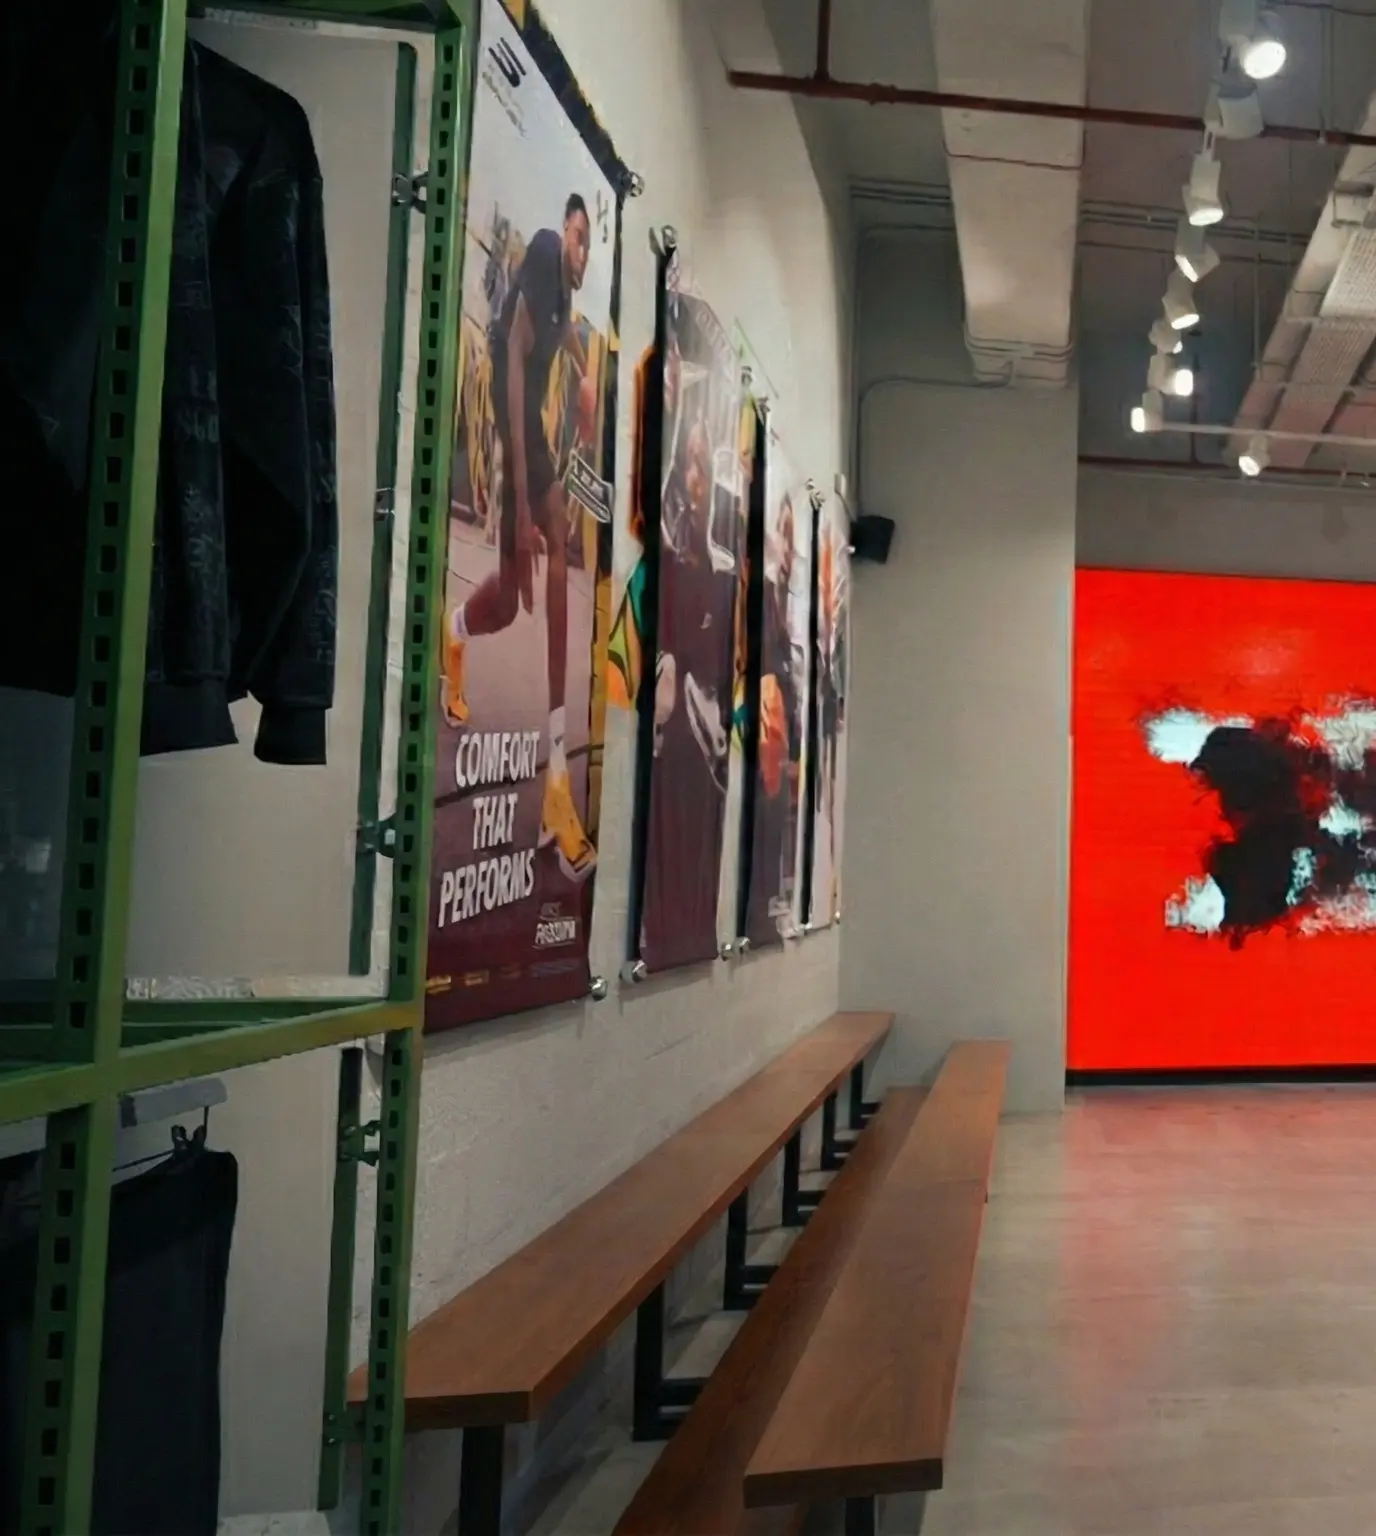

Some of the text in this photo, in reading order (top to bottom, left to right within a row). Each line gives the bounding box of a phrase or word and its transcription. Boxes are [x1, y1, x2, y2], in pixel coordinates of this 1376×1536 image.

[455, 731, 540, 788] COMFORT
[473, 793, 518, 850] THAT
[438, 848, 535, 928] PERFORMS
